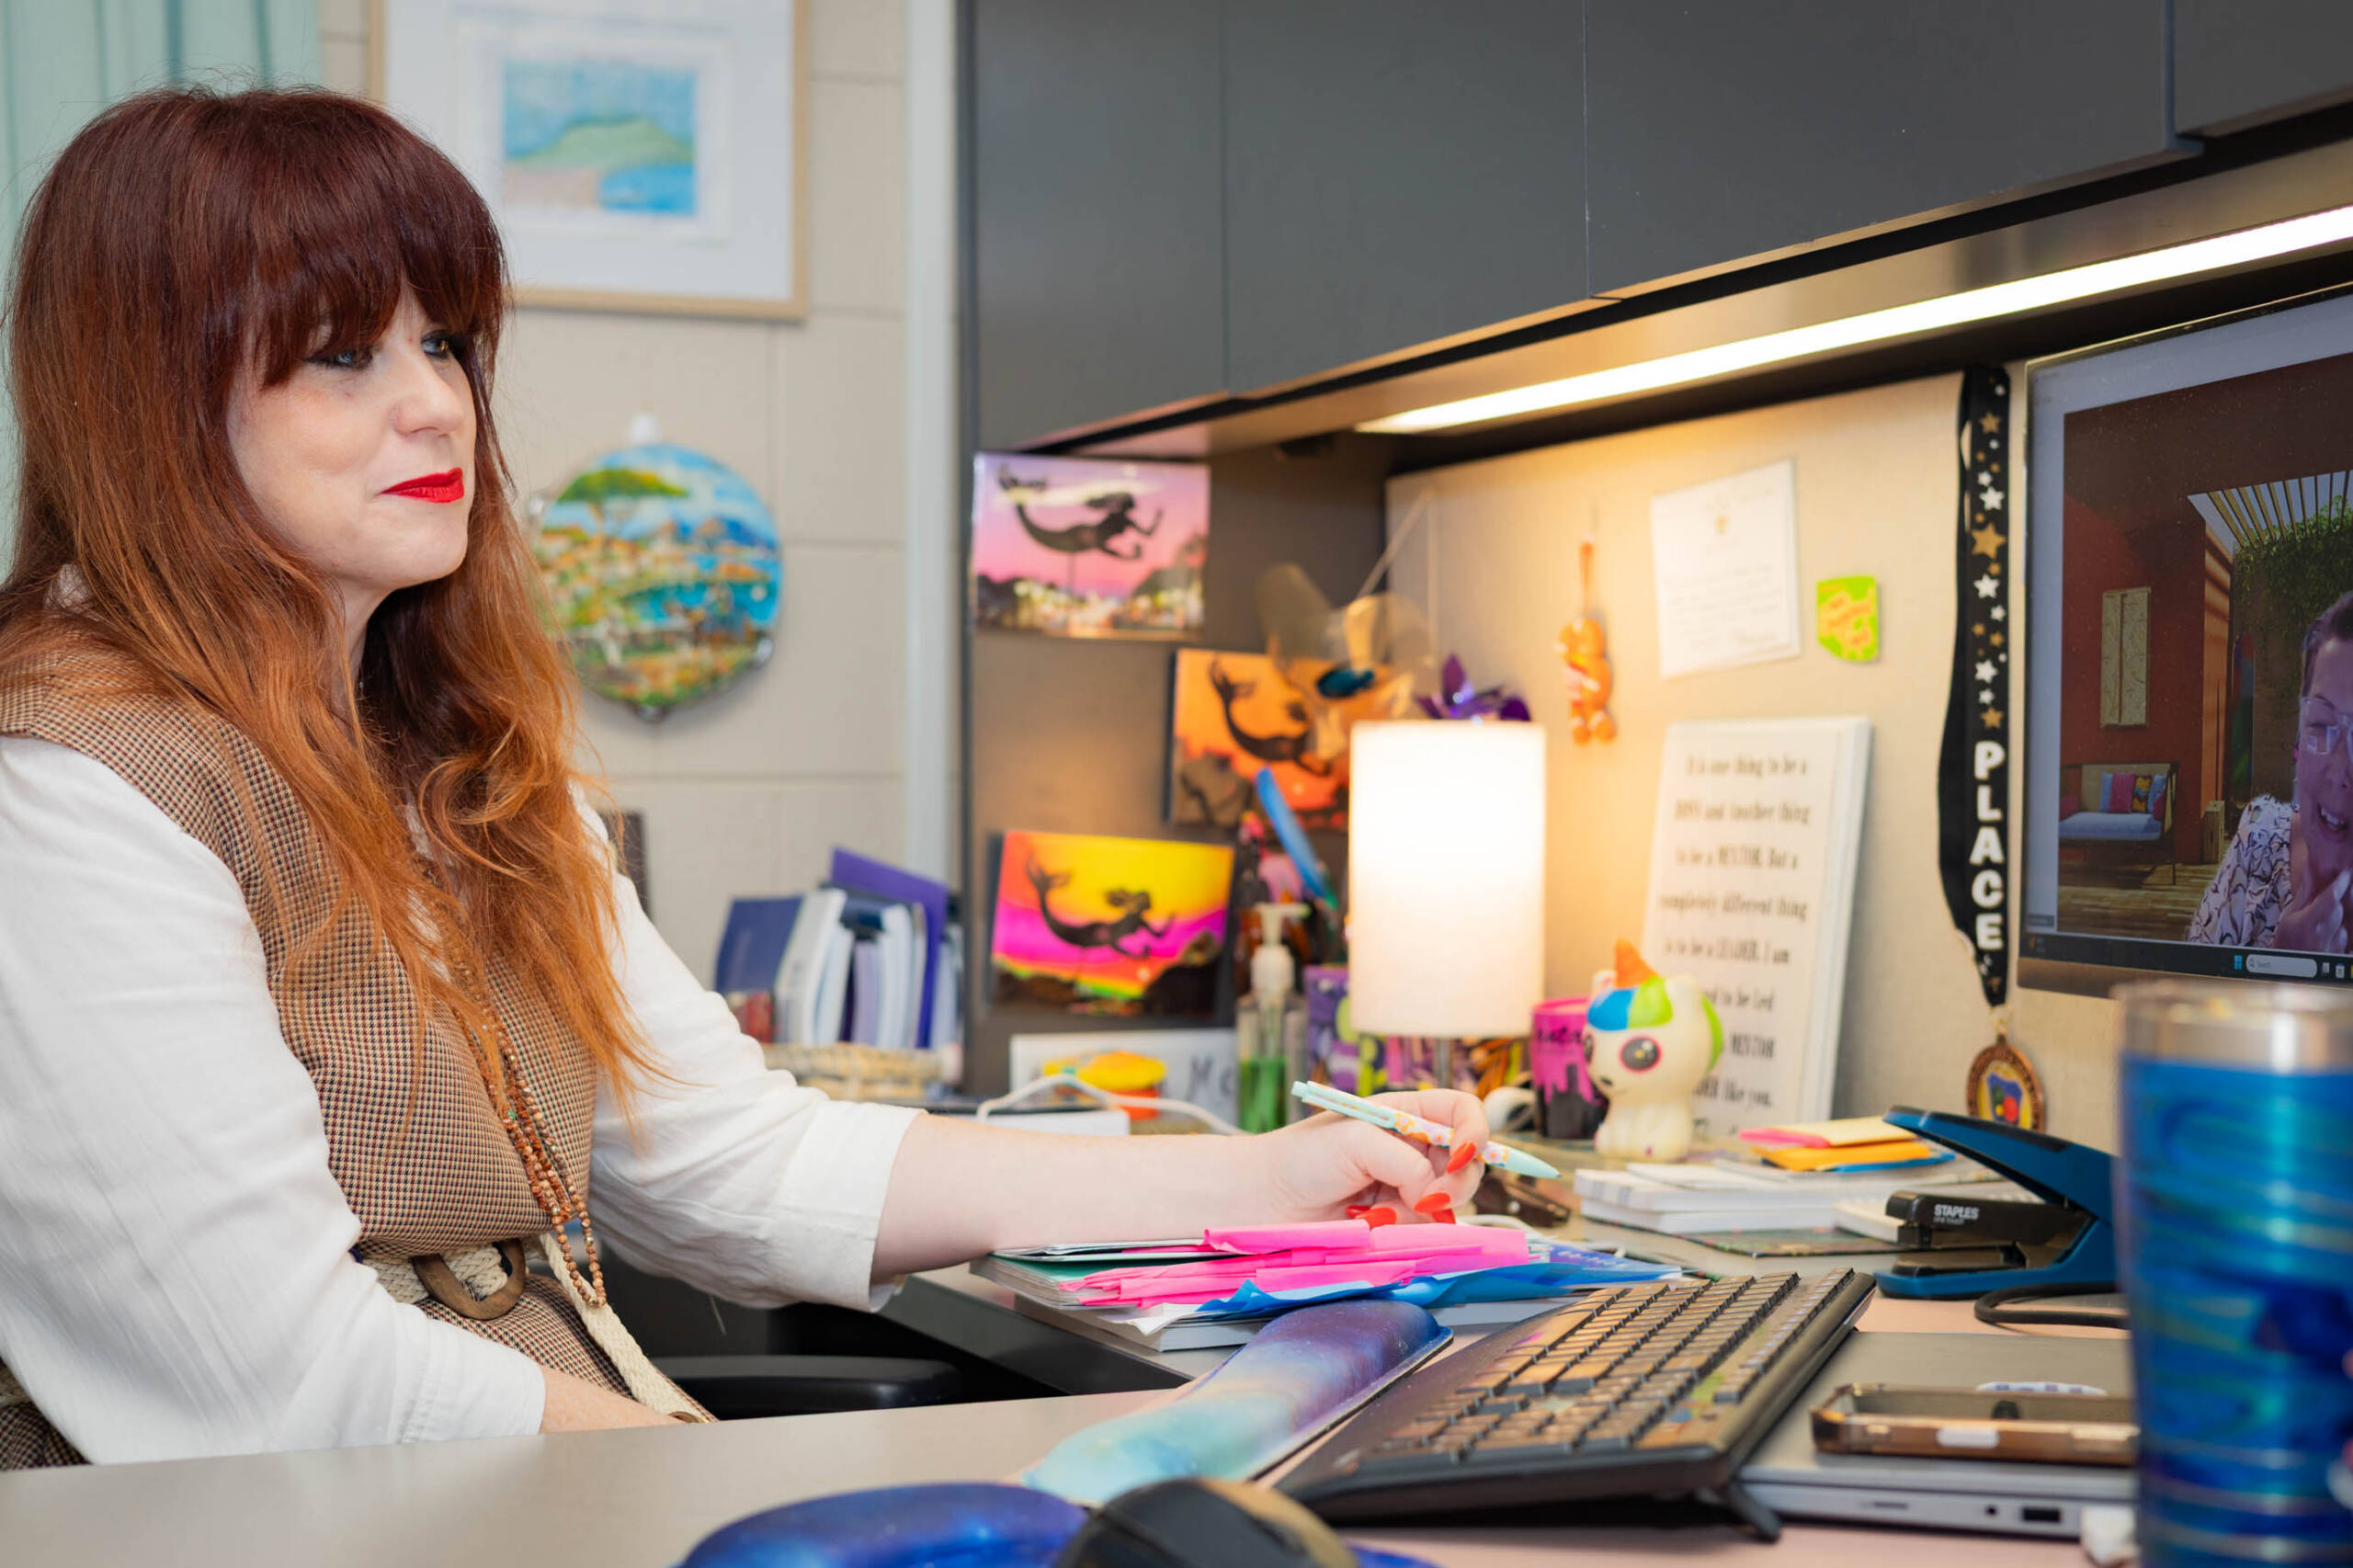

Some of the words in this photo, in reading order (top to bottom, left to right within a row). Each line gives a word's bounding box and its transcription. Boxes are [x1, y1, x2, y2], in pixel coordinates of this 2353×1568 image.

[1734, 754, 1764, 780] thing
[1768, 756, 1779, 775] to
[1782, 751, 1798, 776] be
[1704, 801, 1725, 822] and
[1729, 801, 1775, 822] another
[1779, 801, 1811, 826] thing
[1970, 740, 2006, 949] PLACE
[1721, 891, 1772, 917] different
[1776, 894, 1808, 923] thing
[1773, 948, 1790, 964] am
[1722, 1077, 1745, 1102] like
[1934, 1203, 1980, 1220] STAPLES
